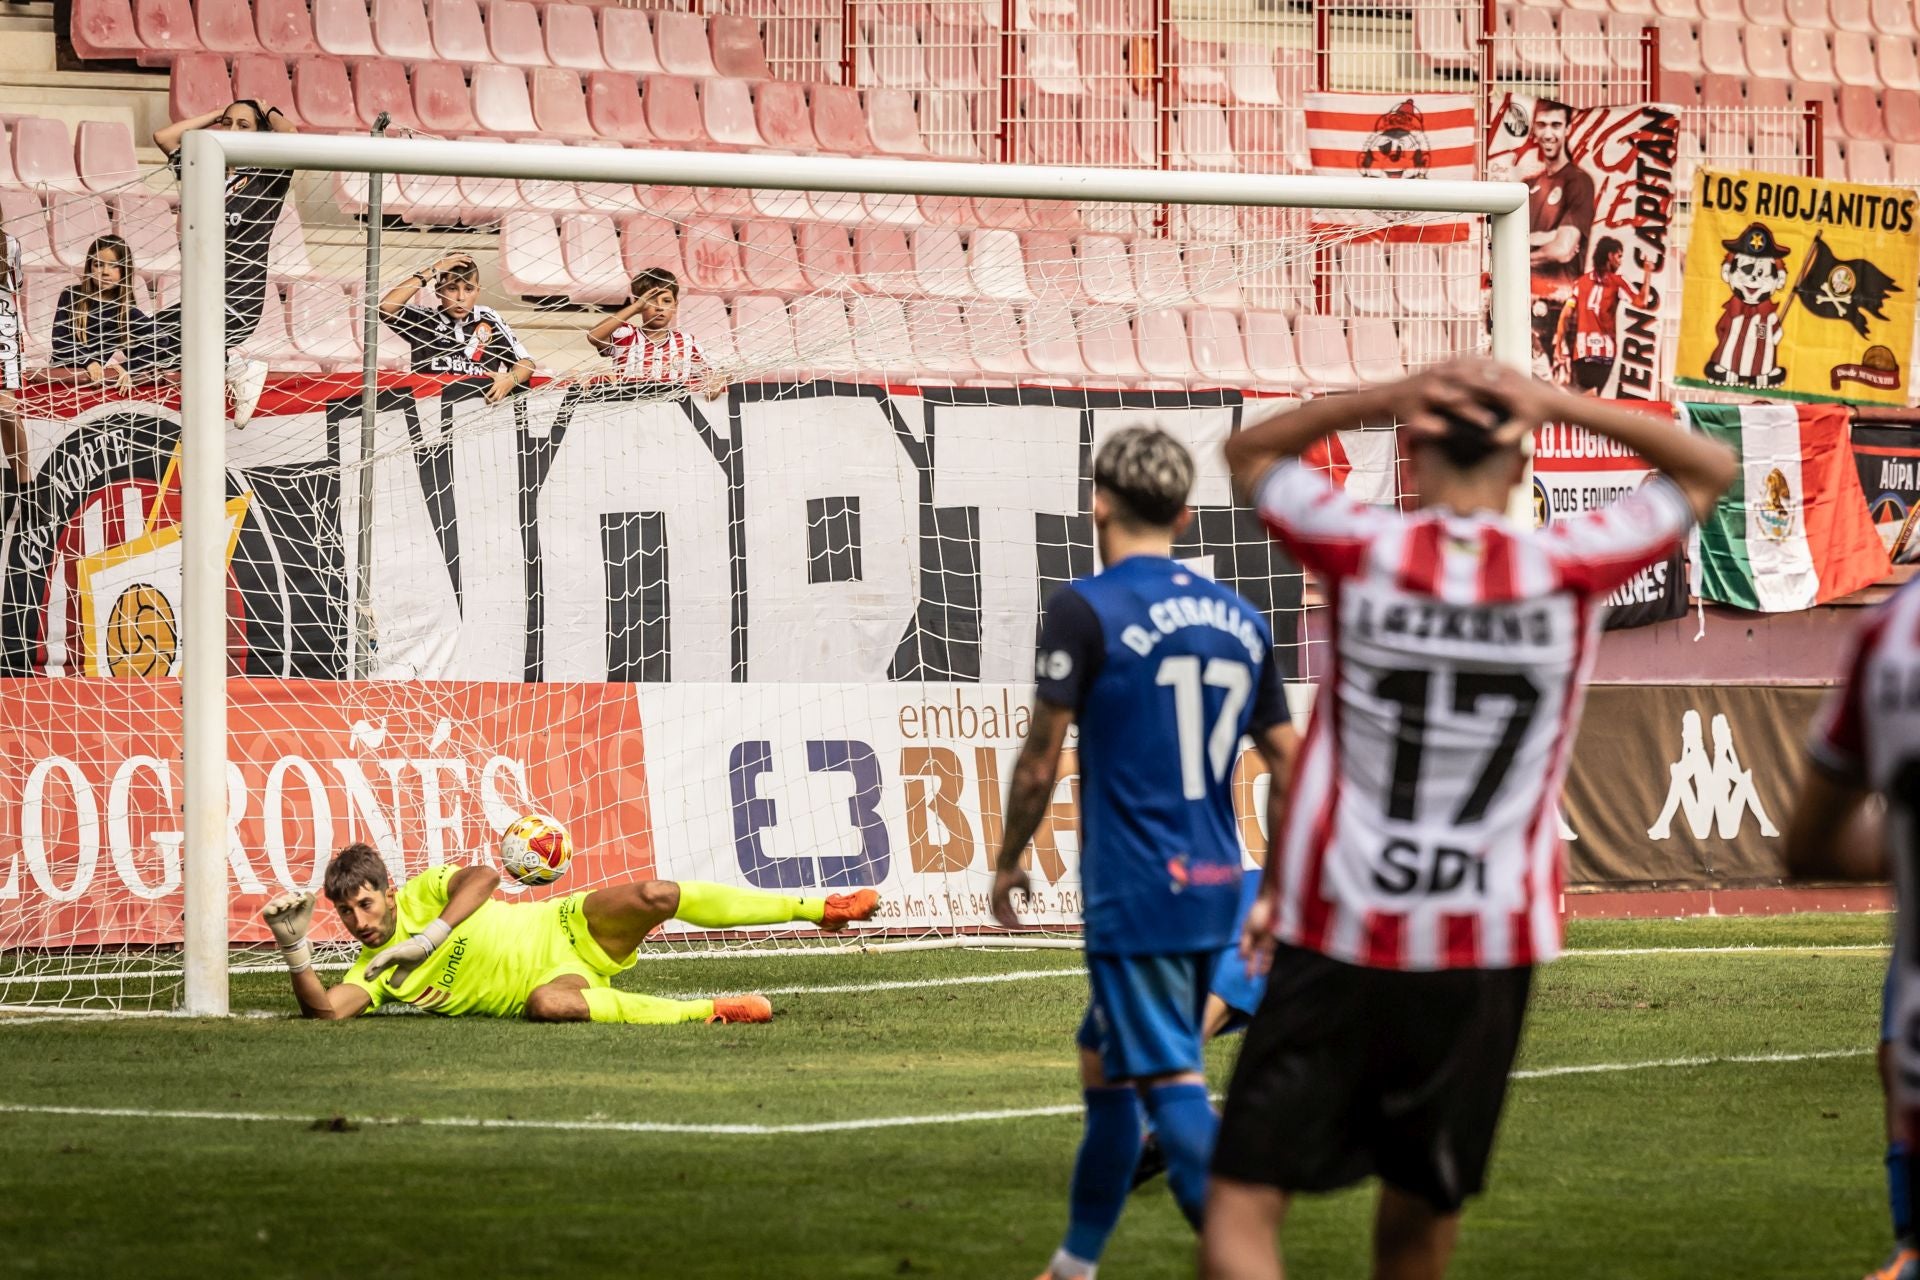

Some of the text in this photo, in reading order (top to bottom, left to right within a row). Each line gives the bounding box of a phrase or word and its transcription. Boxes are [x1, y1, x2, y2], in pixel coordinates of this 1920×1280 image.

[1702, 175, 1914, 233] LOS RIOJANITOS
[1616, 107, 1676, 400] TERNO CAPITÁN
[52, 429, 129, 510] NORTE
[1879, 457, 1914, 491] AÚPA
[1552, 487, 1578, 512] DOS
[1121, 624, 1161, 657] D.
[899, 688, 1080, 740] embala
[1155, 656, 1251, 801] 17
[1373, 669, 1540, 826] 17
[0, 717, 534, 901] OGROÑÉS
[905, 895, 925, 917] Km
[929, 894, 942, 917] 3.
[944, 892, 968, 916] Tel.
[1058, 891, 1083, 914] 261
[437, 936, 469, 989] lointek
